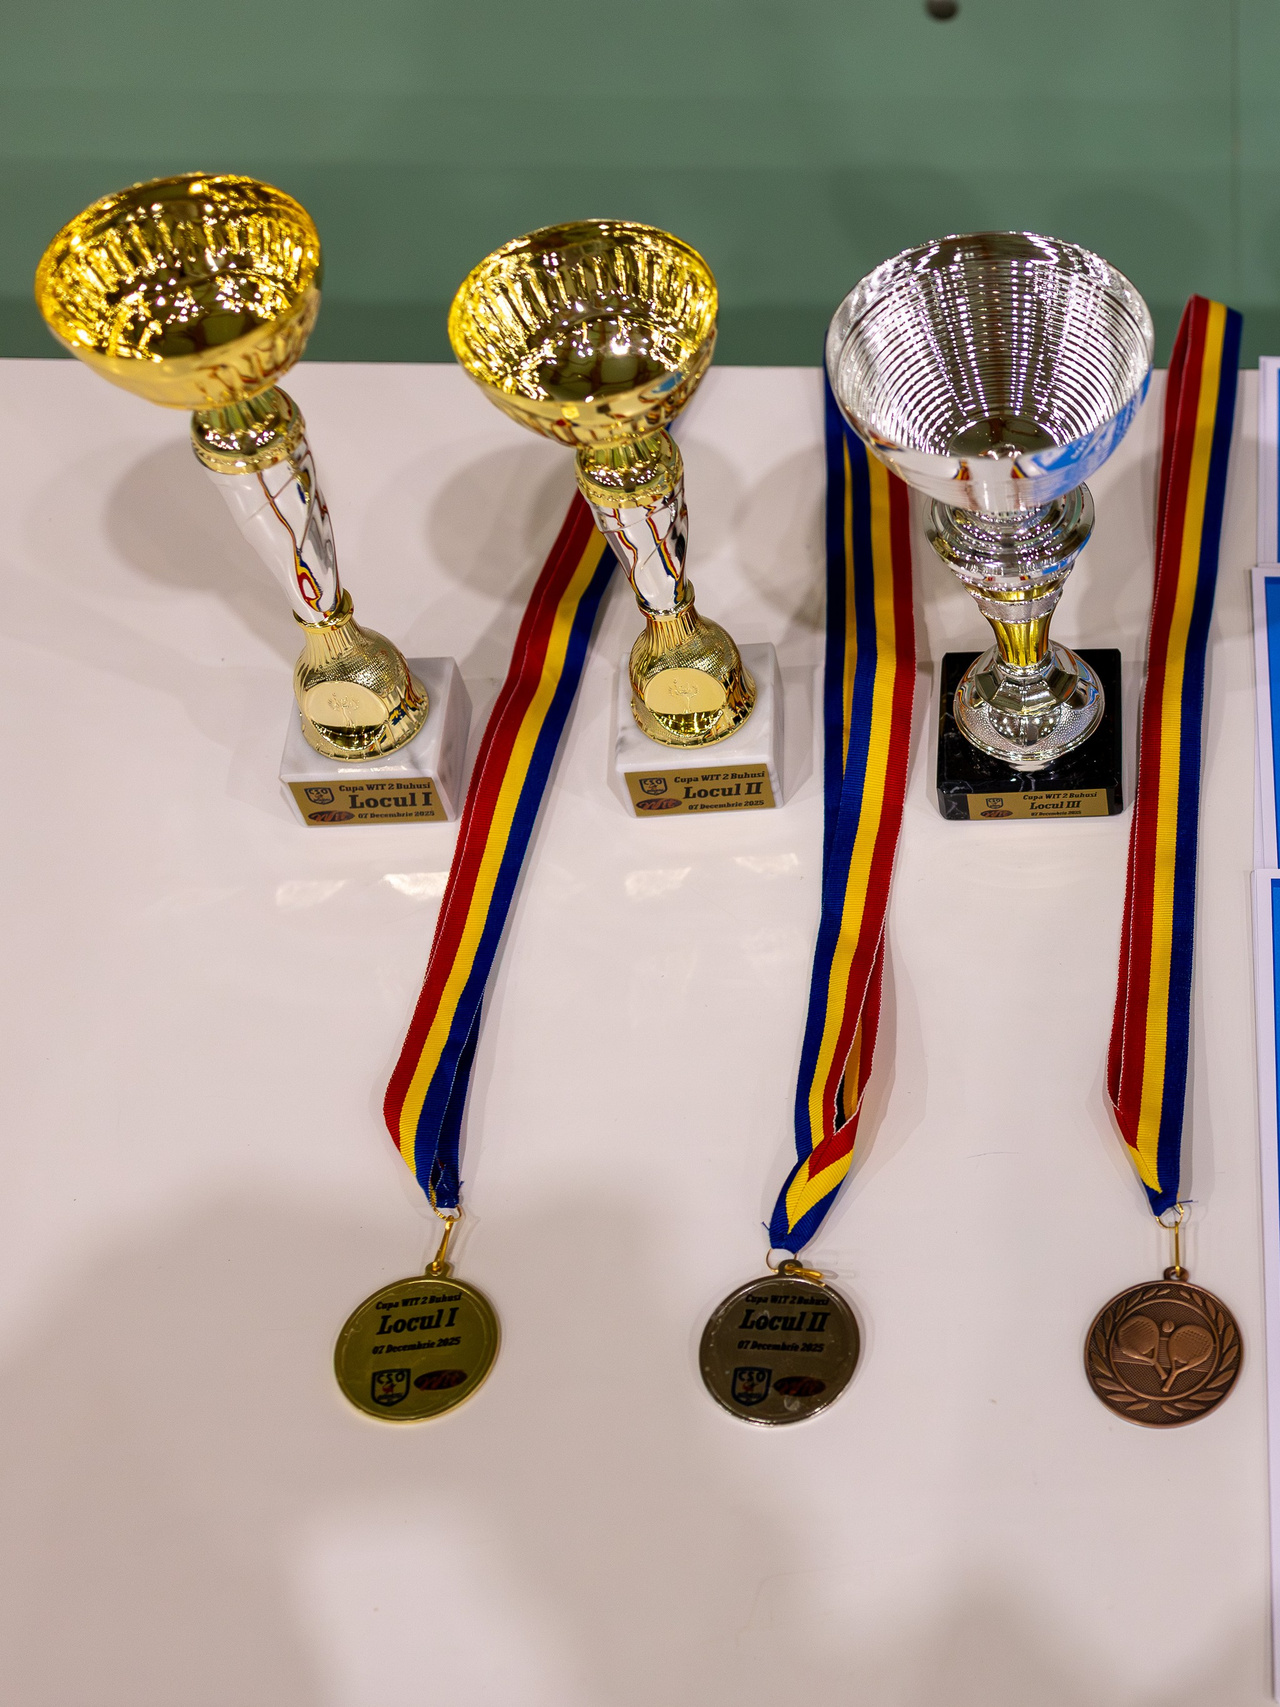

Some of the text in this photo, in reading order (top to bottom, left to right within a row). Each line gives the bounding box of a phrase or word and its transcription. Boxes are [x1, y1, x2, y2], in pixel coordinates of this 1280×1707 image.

[674, 771, 765, 784] Cupa WIT 2 Buhusi
[338, 784, 365, 793] Cupa
[366, 783, 386, 791] WIT
[395, 782, 431, 790] Buhusi
[683, 782, 764, 800] Locul II
[349, 792, 433, 809] Locul I
[700, 802, 743, 810] Decembrie
[1029, 800, 1081, 810] Locul III
[370, 810, 413, 818] Decembrie
[375, 1300, 399, 1311] Cupa
[401, 1297, 421, 1308] WIT
[421, 1296, 428, 1304] 2
[376, 1307, 459, 1335] Locul I
[739, 1309, 831, 1332] Locul II
[385, 1341, 436, 1354] Decembrie
